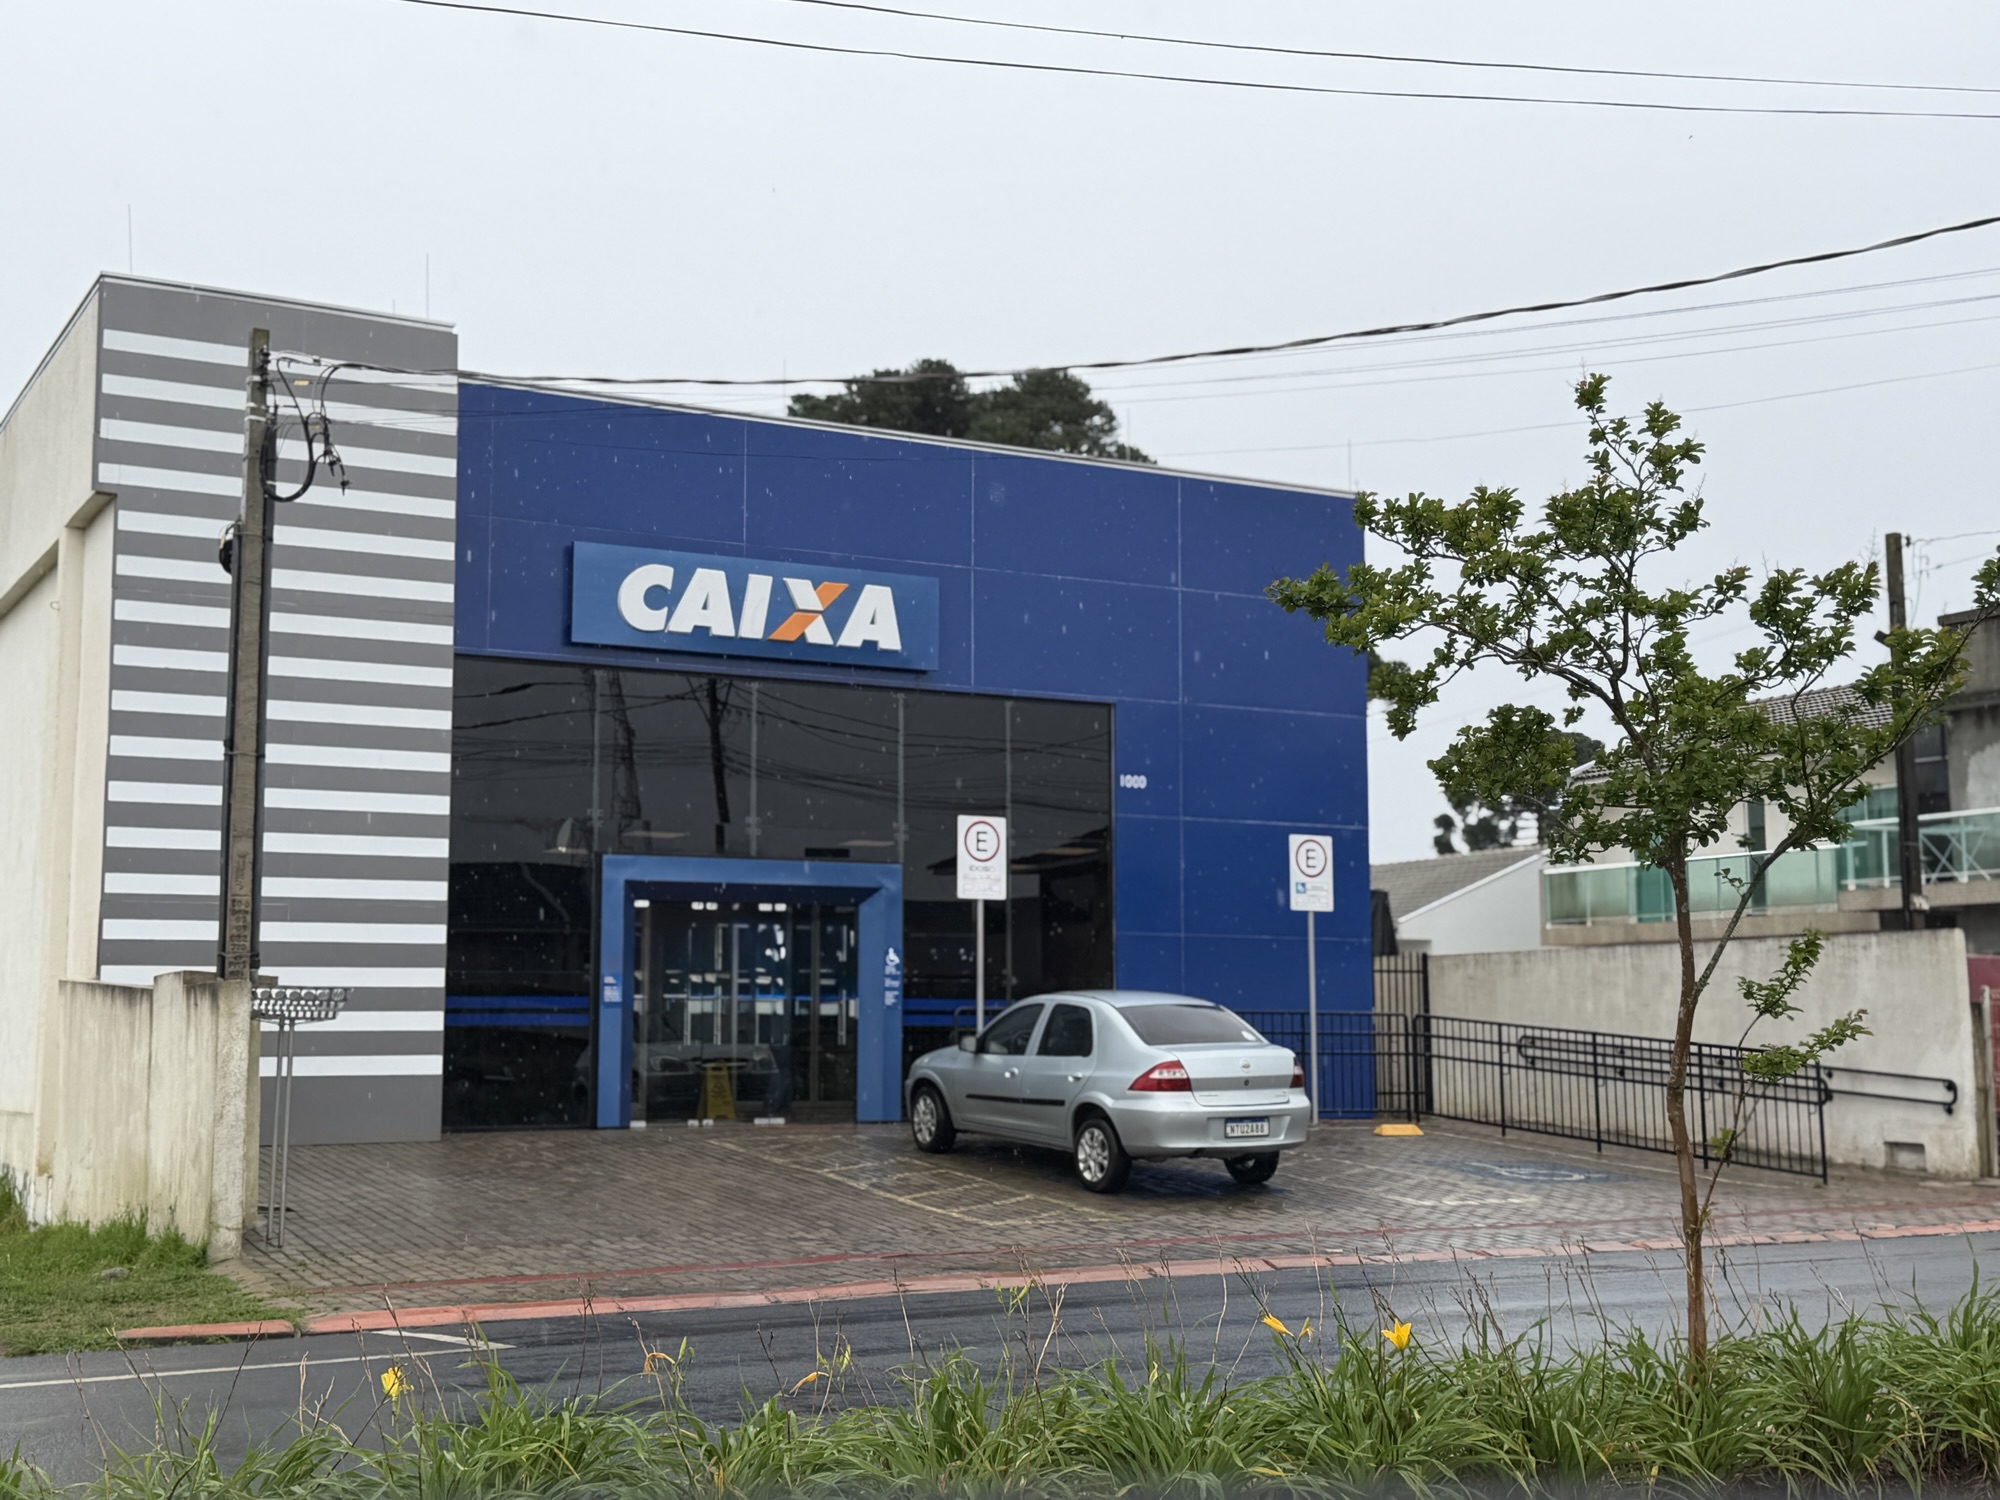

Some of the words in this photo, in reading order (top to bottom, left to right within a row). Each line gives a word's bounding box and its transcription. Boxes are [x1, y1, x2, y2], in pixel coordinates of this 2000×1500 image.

[617, 563, 902, 652] CAIXA
[1119, 774, 1147, 789] 1000
[976, 831, 987, 852] E
[1306, 849, 1316, 868] E
